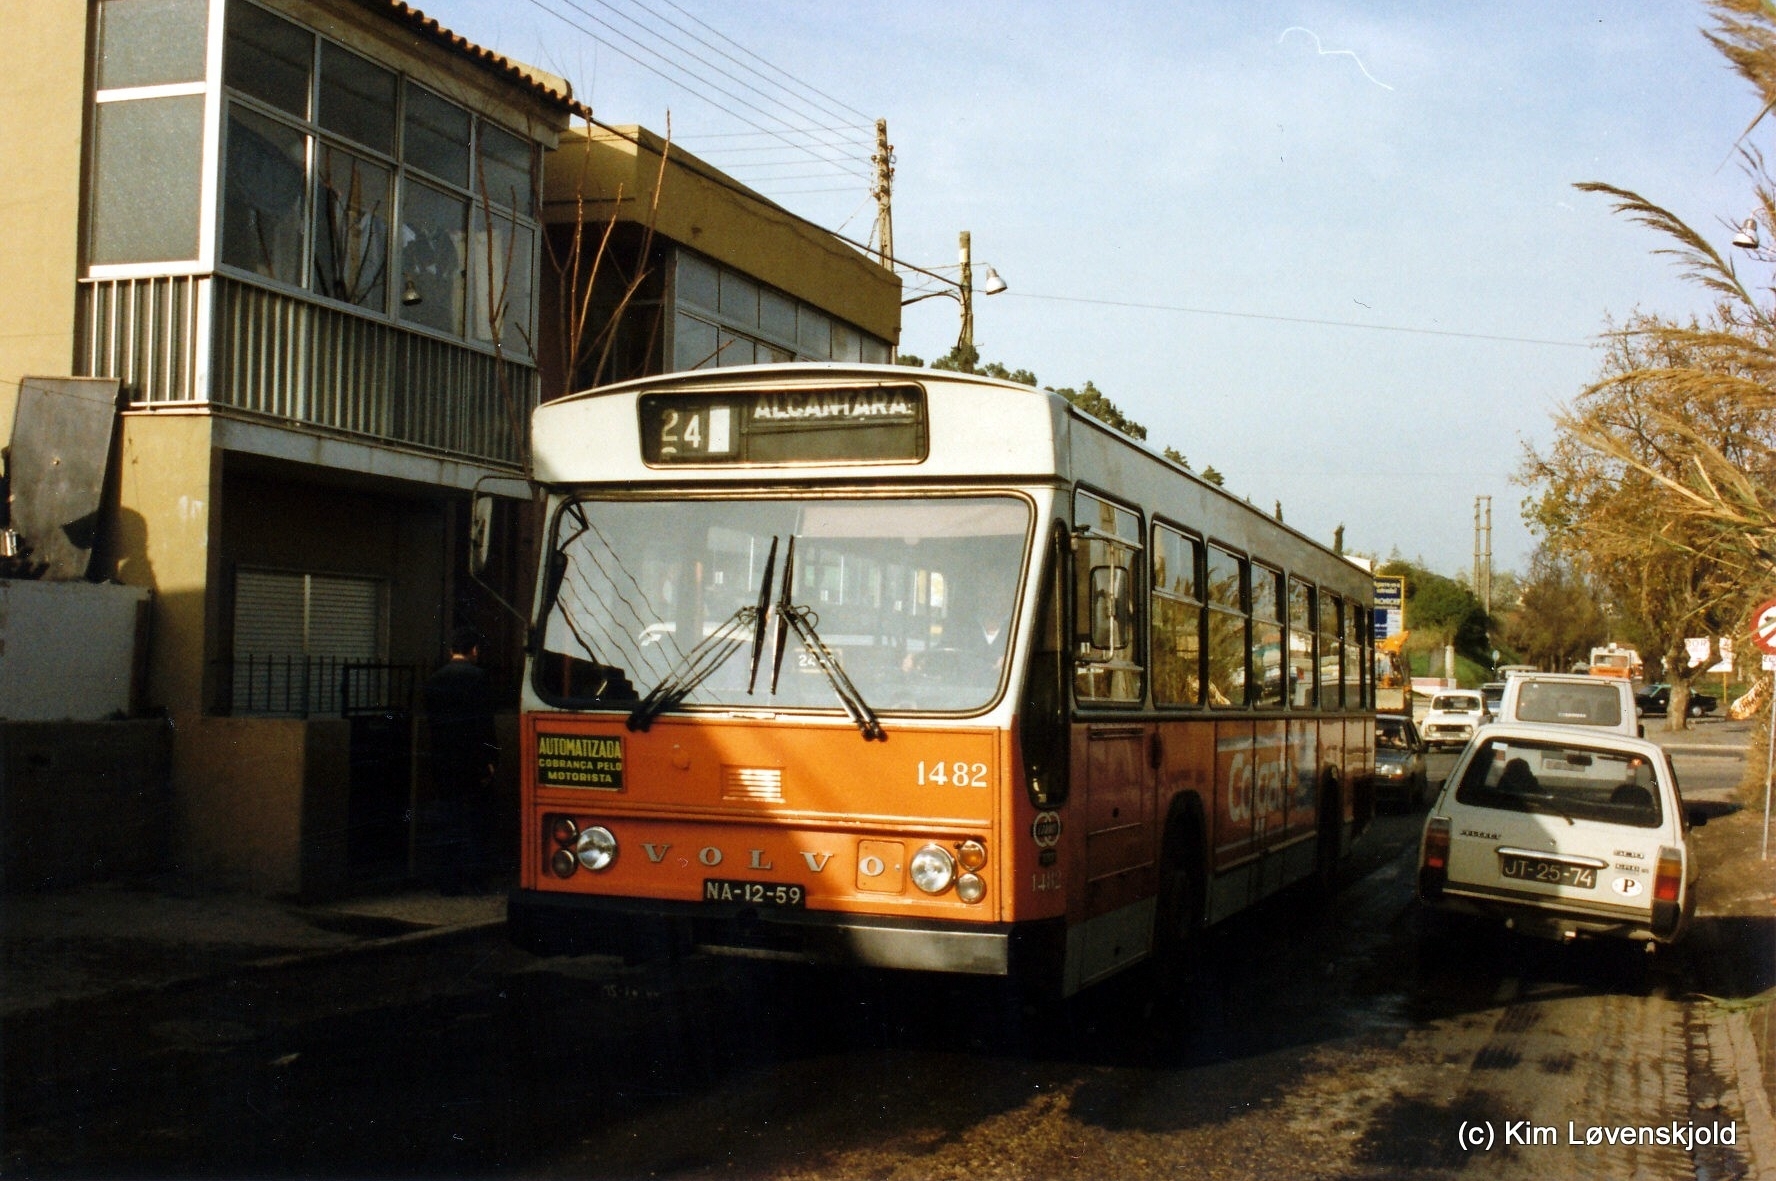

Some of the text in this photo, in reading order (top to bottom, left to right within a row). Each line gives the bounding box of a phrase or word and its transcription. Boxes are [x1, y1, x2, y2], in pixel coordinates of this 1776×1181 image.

[539, 737, 622, 758] AUTOMATIZADA
[548, 771, 612, 783] MOTORISTA
[597, 761, 622, 771] PELO
[918, 760, 988, 788] 1482
[641, 843, 885, 877] VOLVO
[1504, 860, 1593, 887] JT-25-74
[706, 881, 800, 904] NA-12-59
[1623, 878, 1635, 892] P
